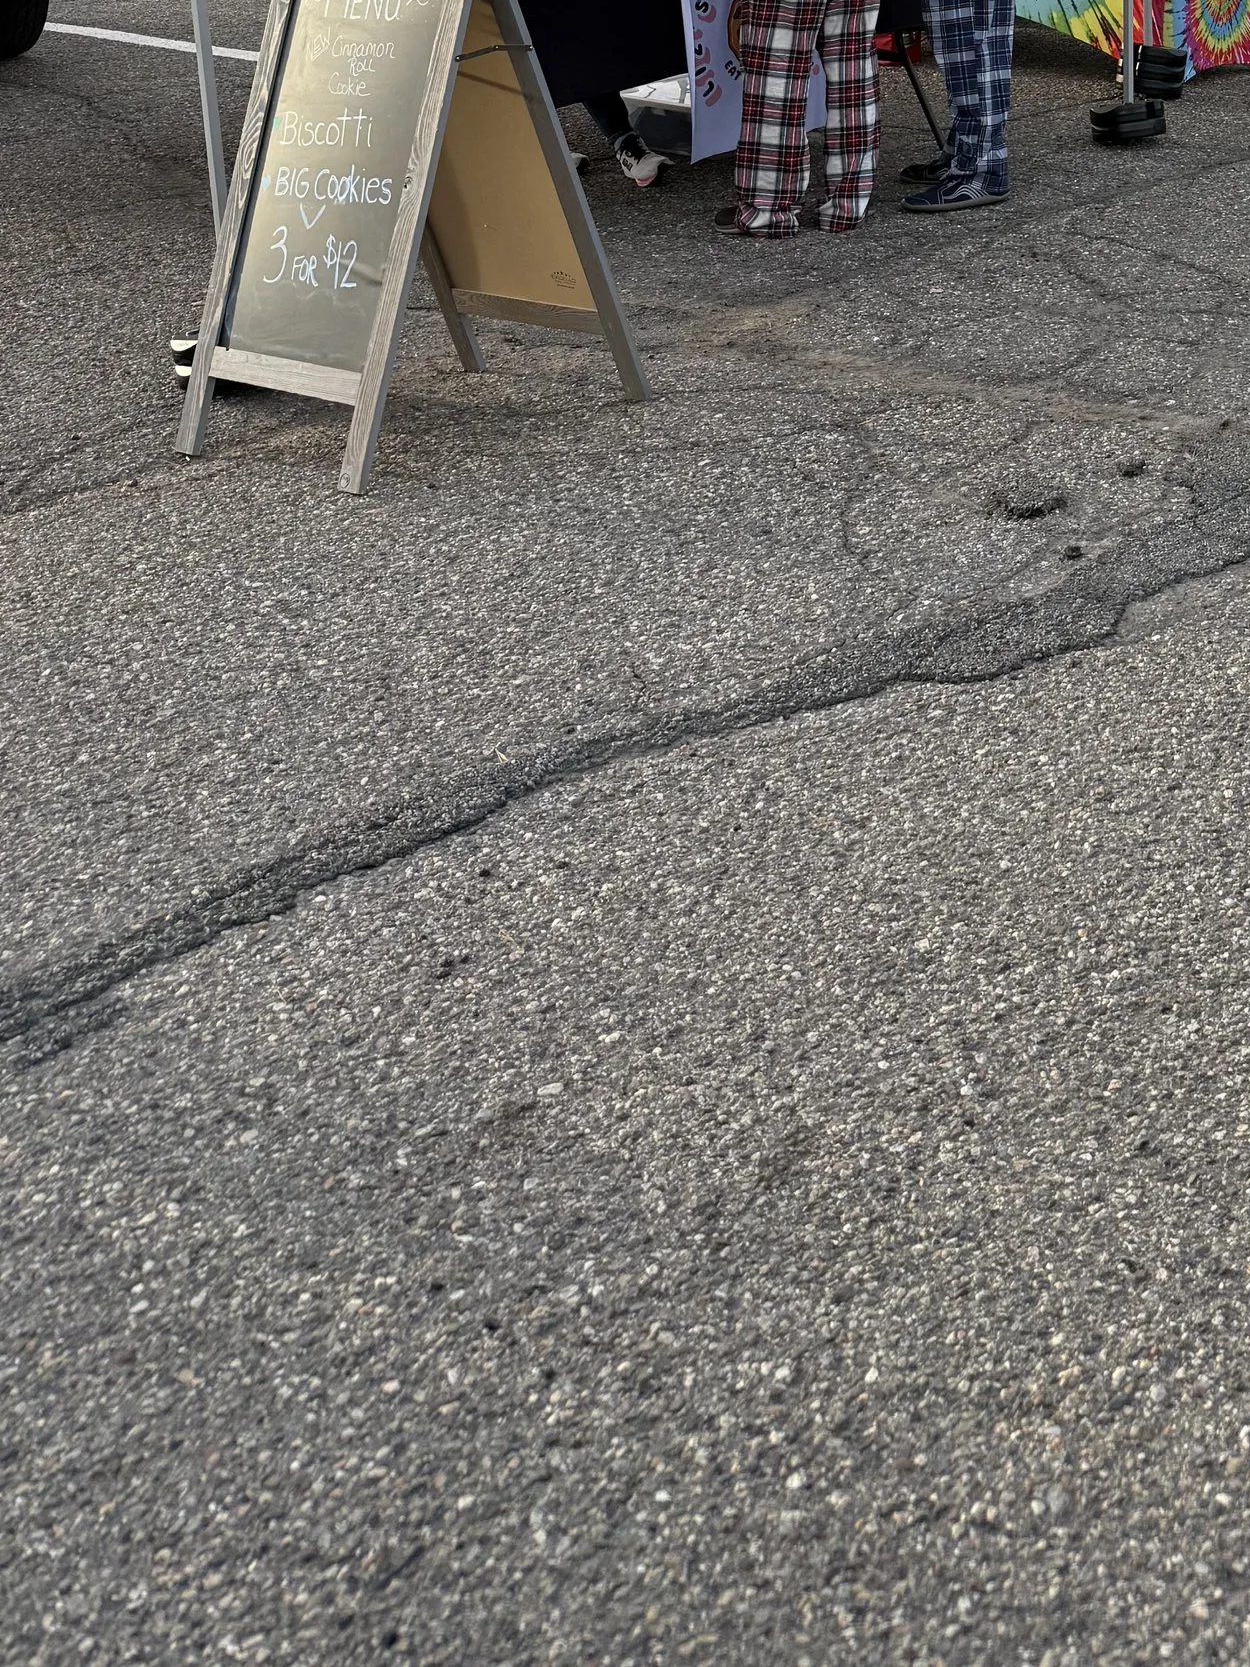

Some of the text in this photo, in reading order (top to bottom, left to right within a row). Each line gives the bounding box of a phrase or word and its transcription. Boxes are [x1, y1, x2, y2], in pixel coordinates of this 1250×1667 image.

[331, 35, 396, 59] Cinnamon
[347, 57, 376, 77] Roll
[724, 60, 742, 81] EAT
[328, 71, 370, 97] Cookie
[280, 108, 374, 148] Biscotti
[274, 164, 393, 205] BIG Cookies
[263, 225, 358, 290] 3 FOR $12
